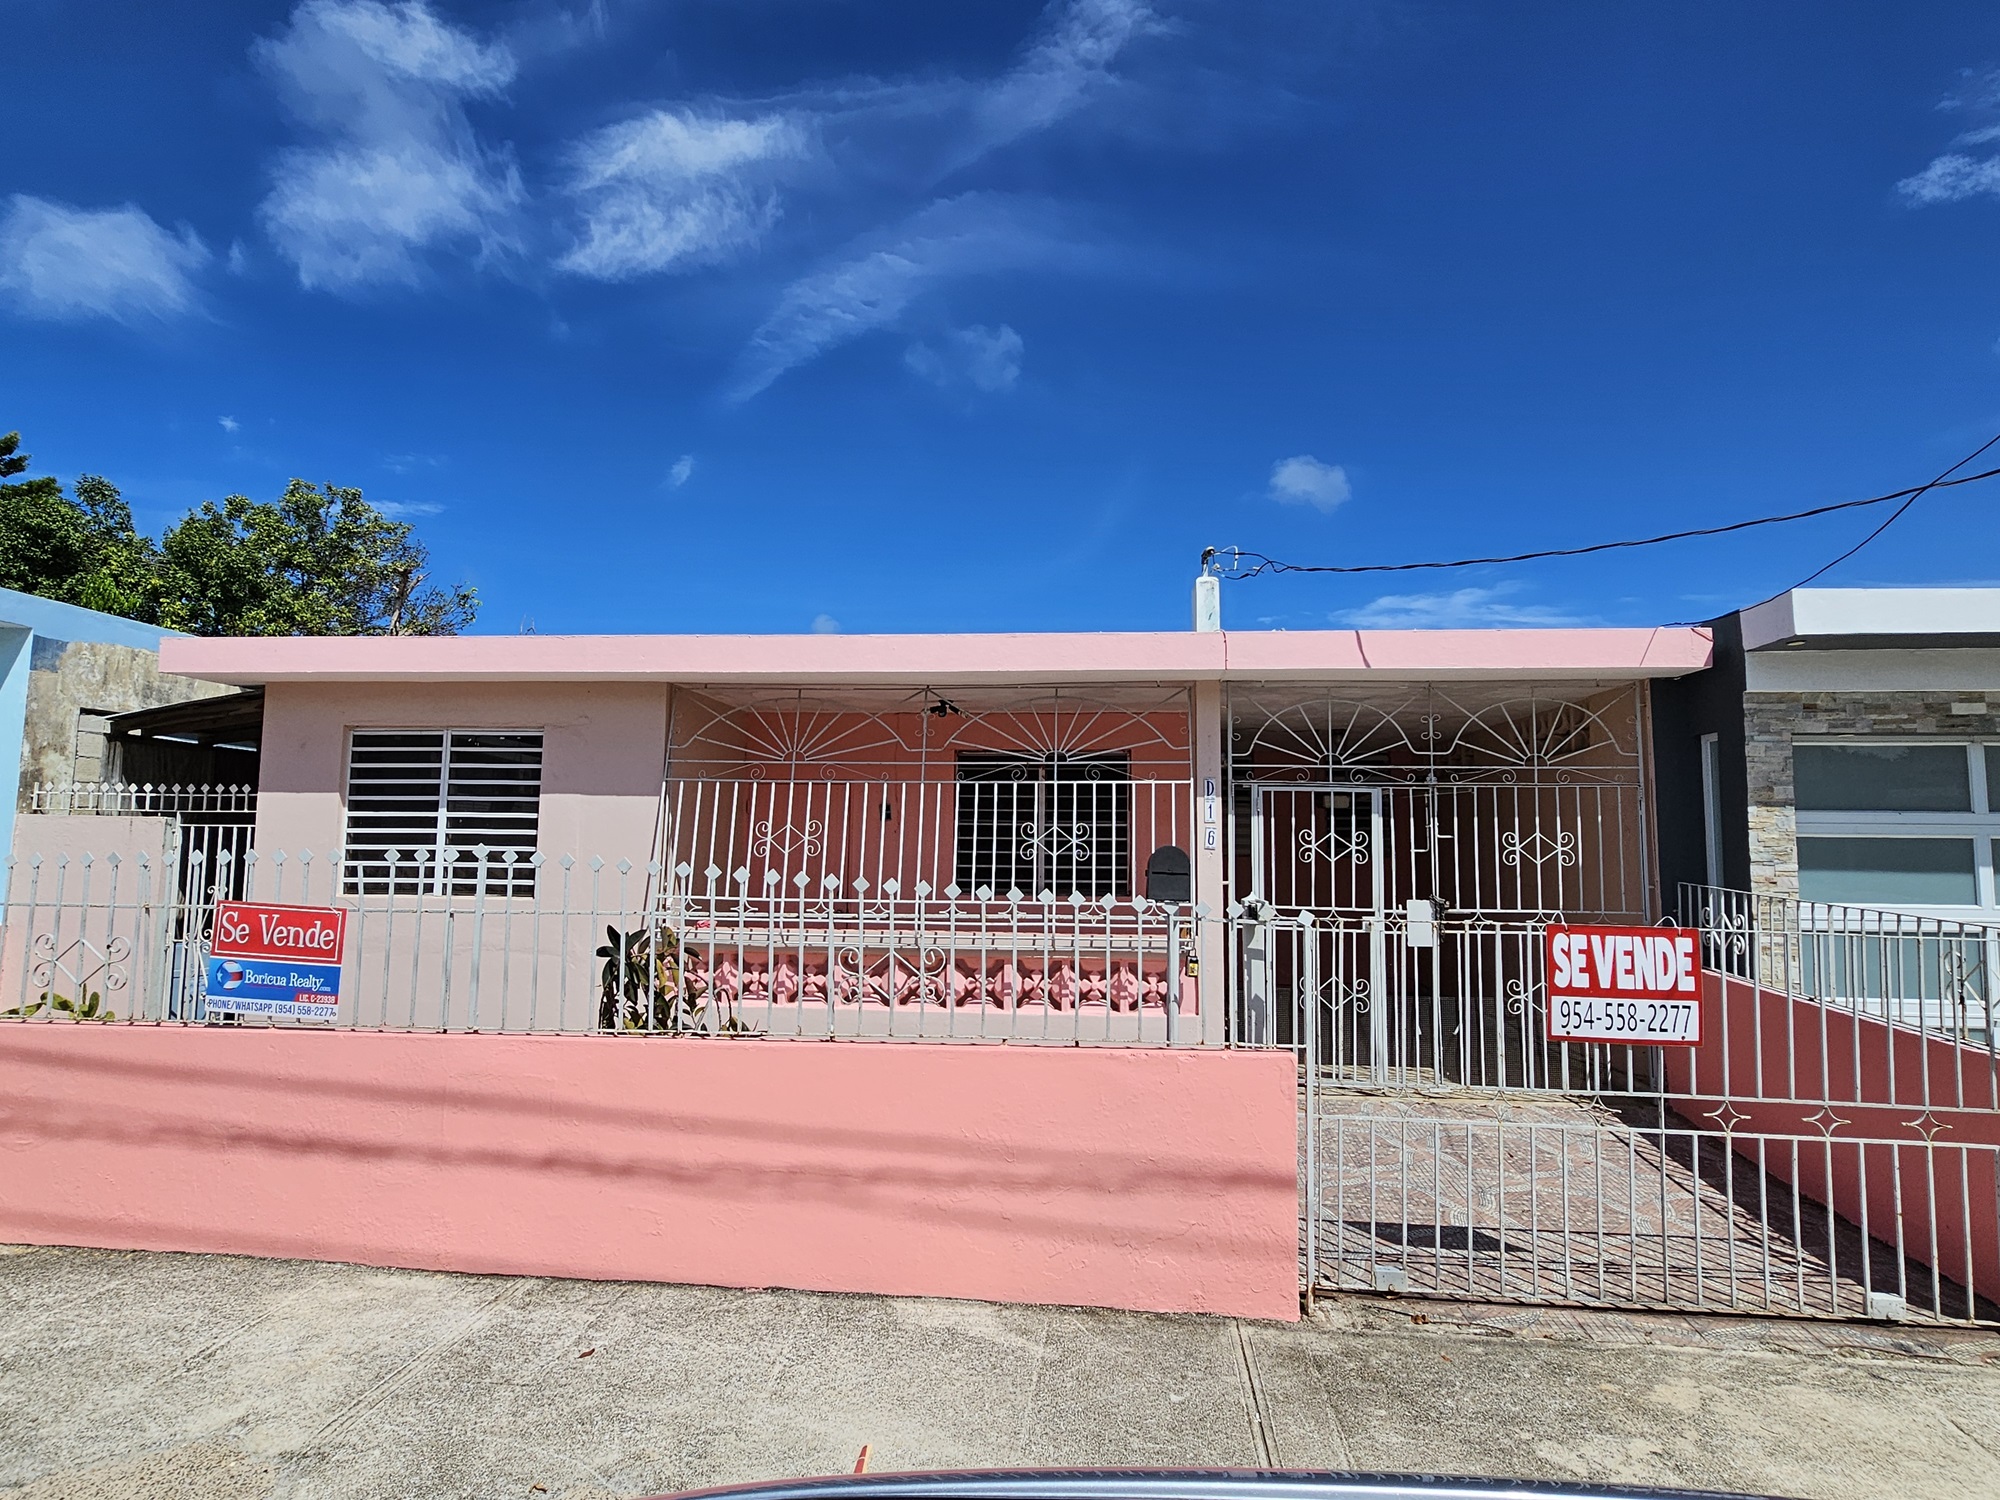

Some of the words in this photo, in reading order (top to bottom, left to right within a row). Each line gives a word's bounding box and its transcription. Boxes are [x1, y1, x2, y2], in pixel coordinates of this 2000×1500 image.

[220, 911, 250, 944] Se
[258, 913, 335, 950] Vende
[1552, 932, 1590, 988] SE
[1590, 935, 1696, 992] VENDE
[244, 969, 287, 987] Boricua
[288, 972, 324, 992] Realty
[274, 1003, 296, 1016] (954)
[297, 1005, 334, 1018] 558-2277
[1560, 1000, 1692, 1034] 954-558-2277
